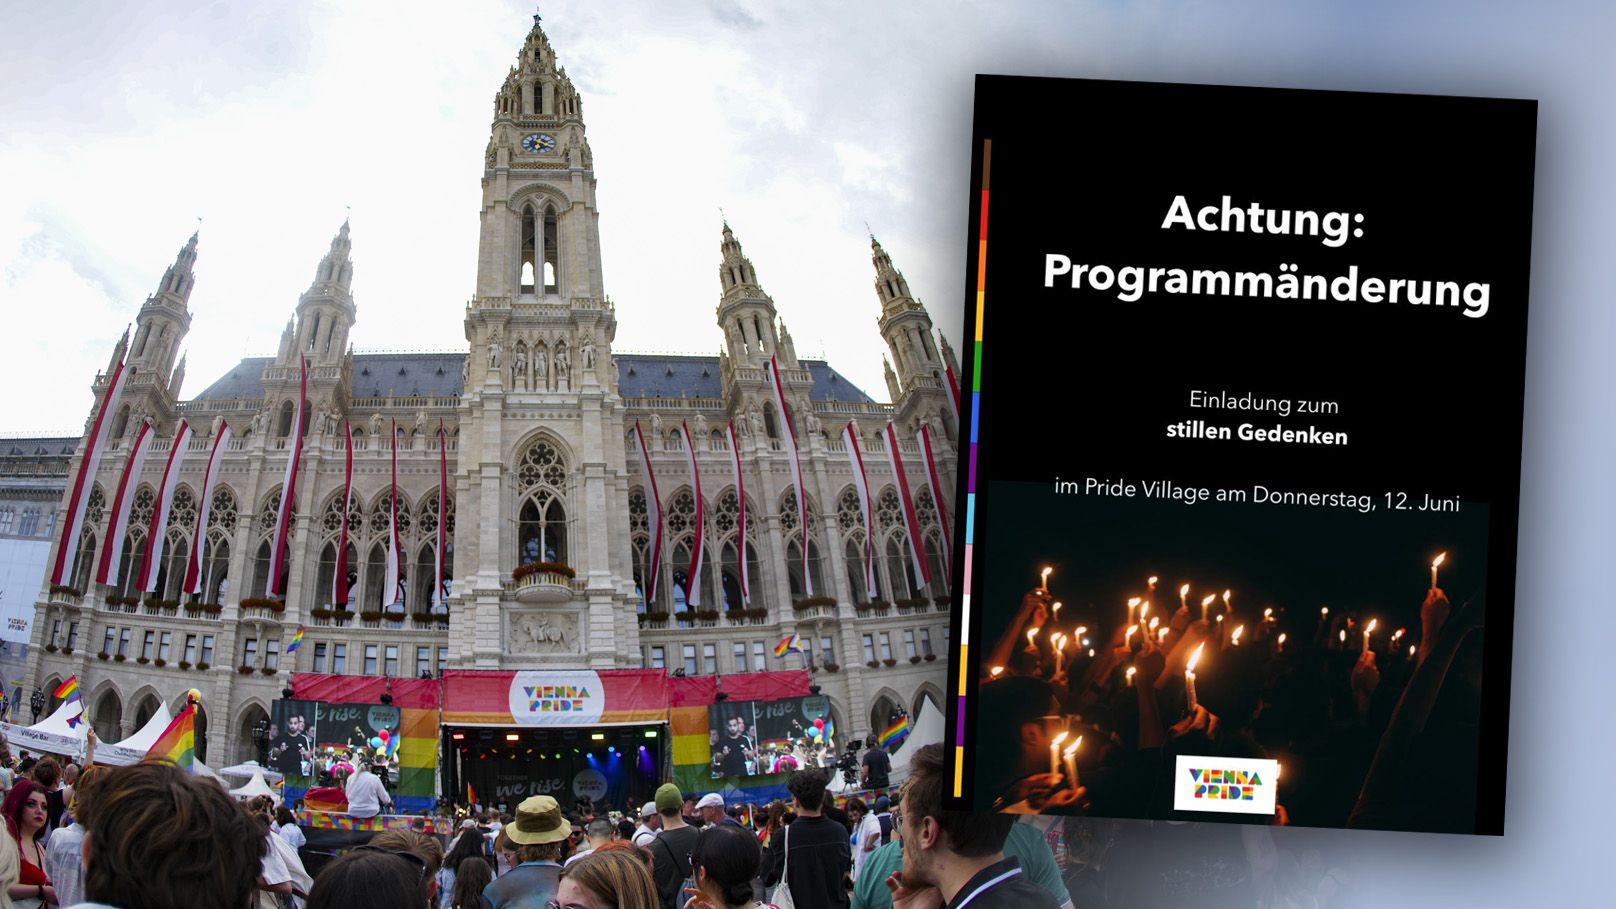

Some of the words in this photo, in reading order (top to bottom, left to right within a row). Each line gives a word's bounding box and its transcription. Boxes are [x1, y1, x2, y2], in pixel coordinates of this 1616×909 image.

[523, 686, 591, 699] VIENNA
[529, 700, 583, 712] PRIDE
[329, 706, 361, 722] rise.
[21, 729, 39, 740] Village
[496, 782, 527, 797] we
[529, 778, 566, 796] rise.
